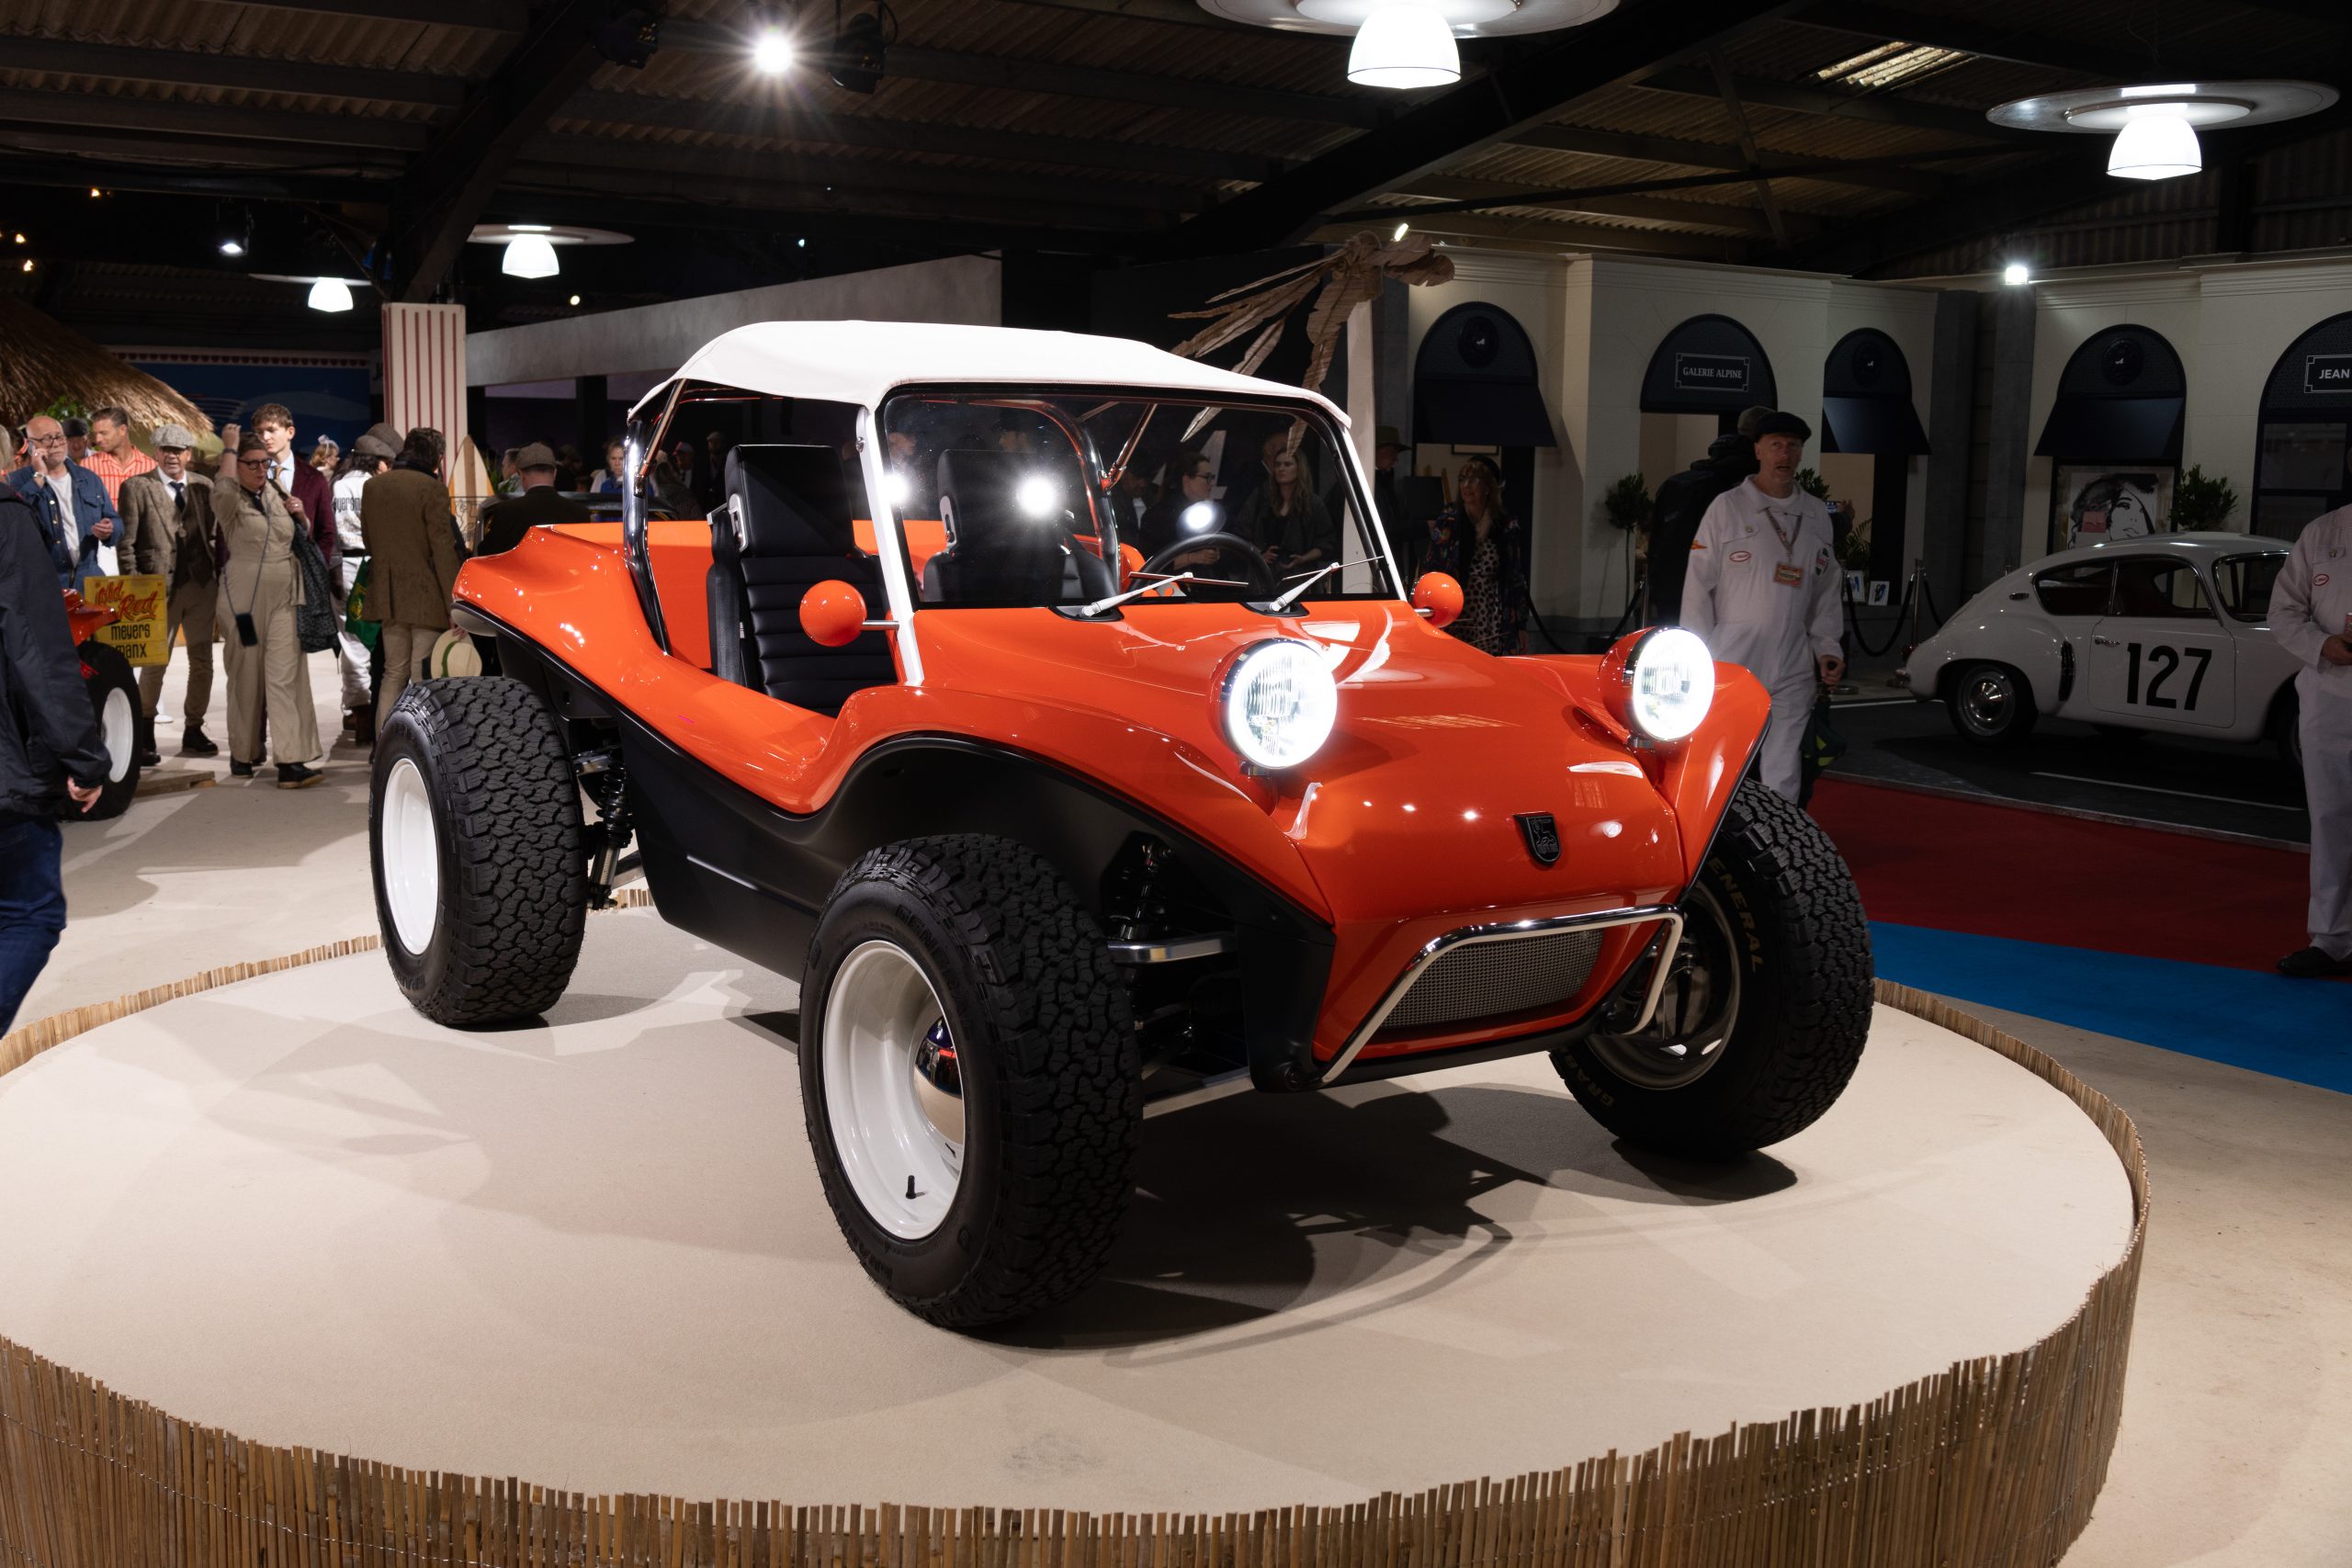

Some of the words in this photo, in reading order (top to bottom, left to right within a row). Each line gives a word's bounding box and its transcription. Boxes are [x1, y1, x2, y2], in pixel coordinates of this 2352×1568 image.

[1682, 367, 1714, 378] GALERIE
[1715, 368, 1742, 379] ALPINE
[2318, 368, 2350, 379] JEAN
[2127, 642, 2212, 711] 127
[1706, 855, 1764, 974] ENERAL
